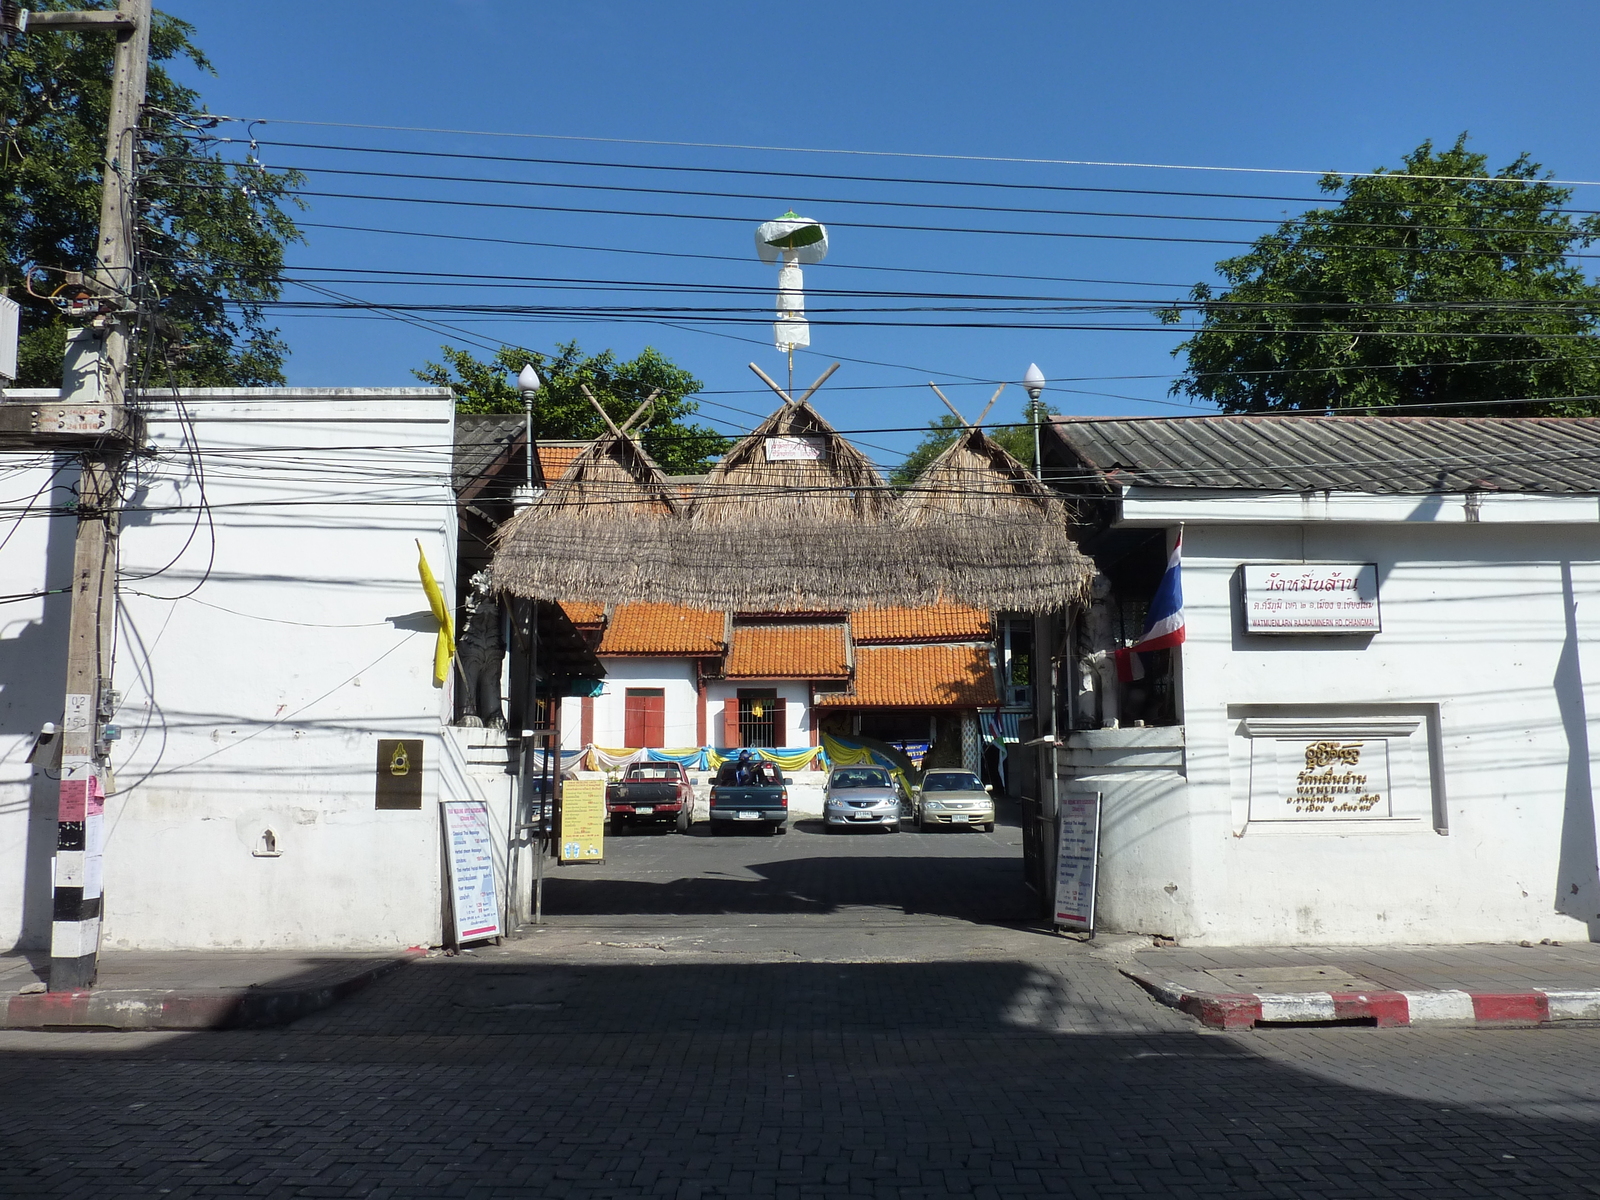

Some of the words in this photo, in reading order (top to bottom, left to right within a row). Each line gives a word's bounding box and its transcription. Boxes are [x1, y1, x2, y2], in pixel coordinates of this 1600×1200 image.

[1265, 570, 1358, 592] วัดหมื่นล้าน
[72, 697, 85, 706] 02
